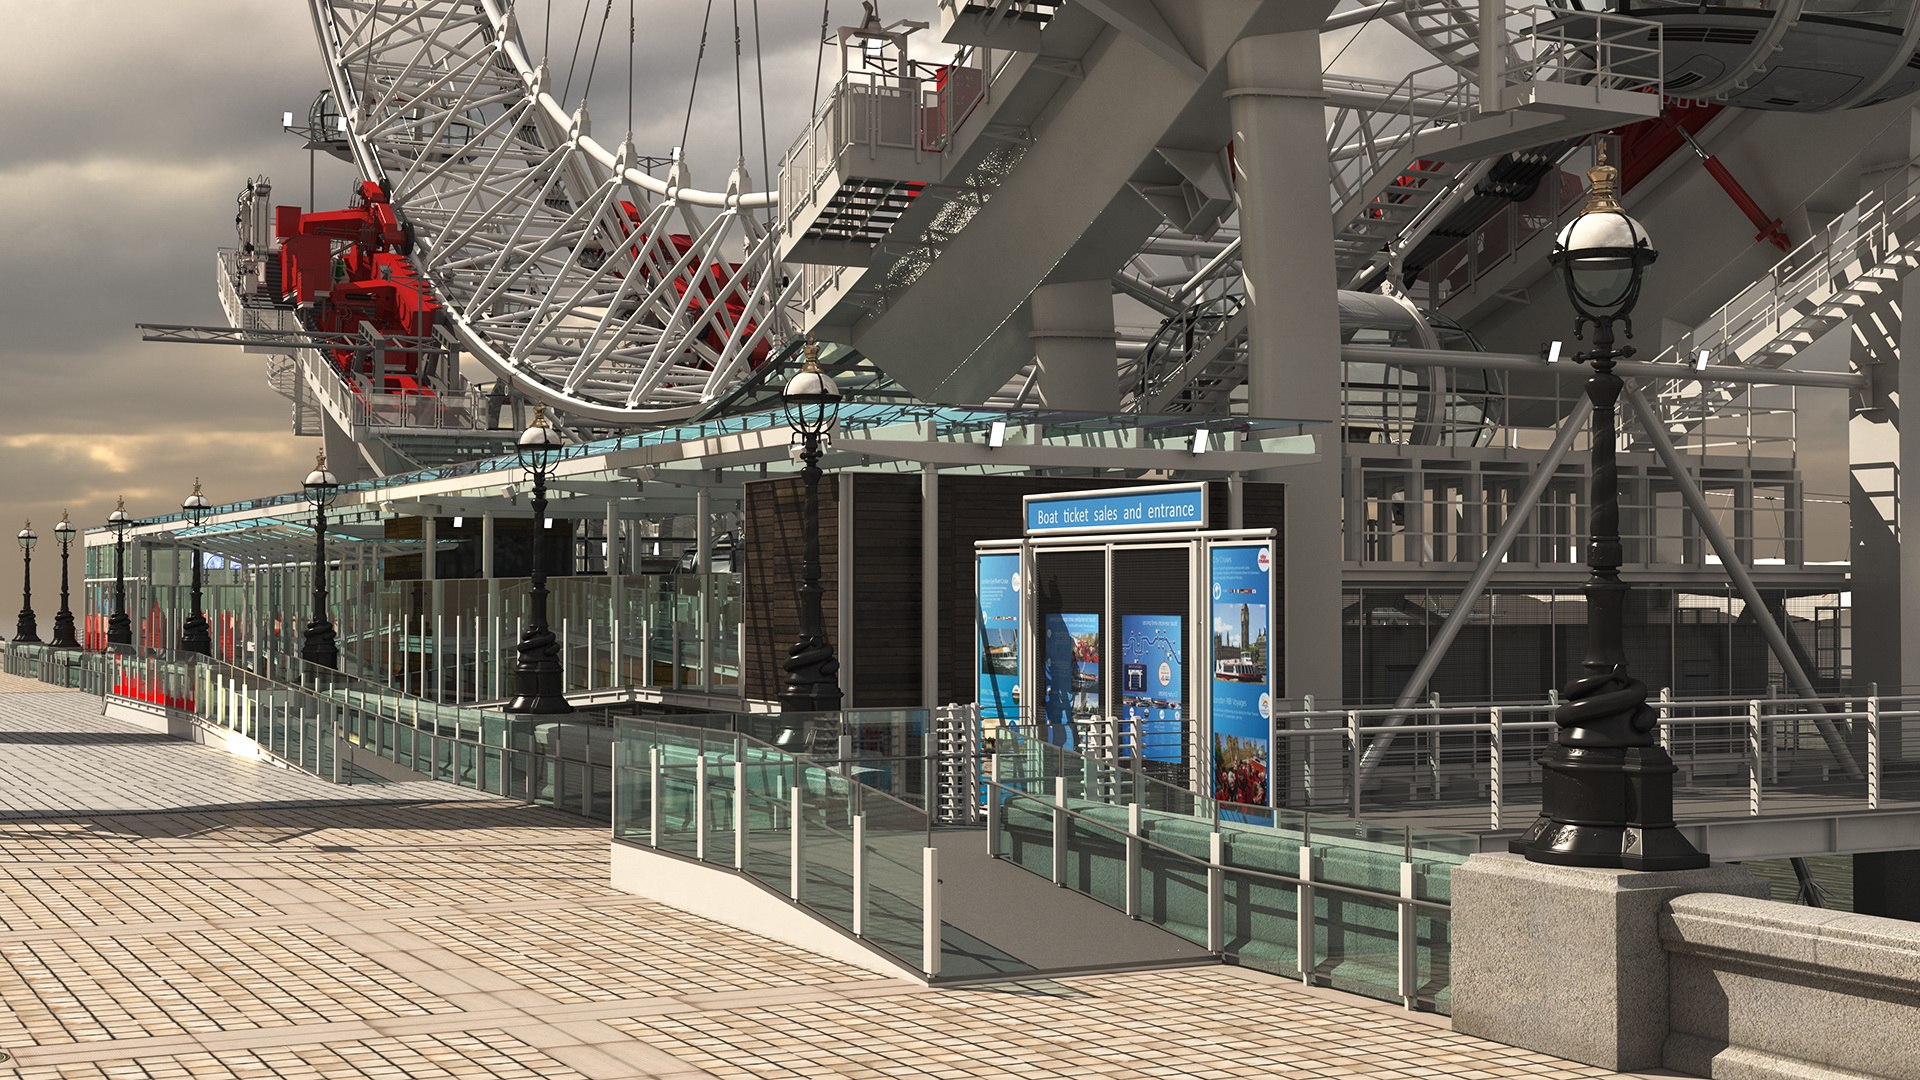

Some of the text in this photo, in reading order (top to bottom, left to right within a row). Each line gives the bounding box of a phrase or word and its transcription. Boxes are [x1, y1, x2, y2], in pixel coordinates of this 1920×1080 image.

[1037, 503, 1194, 525] Boat ticket sales and entrance
